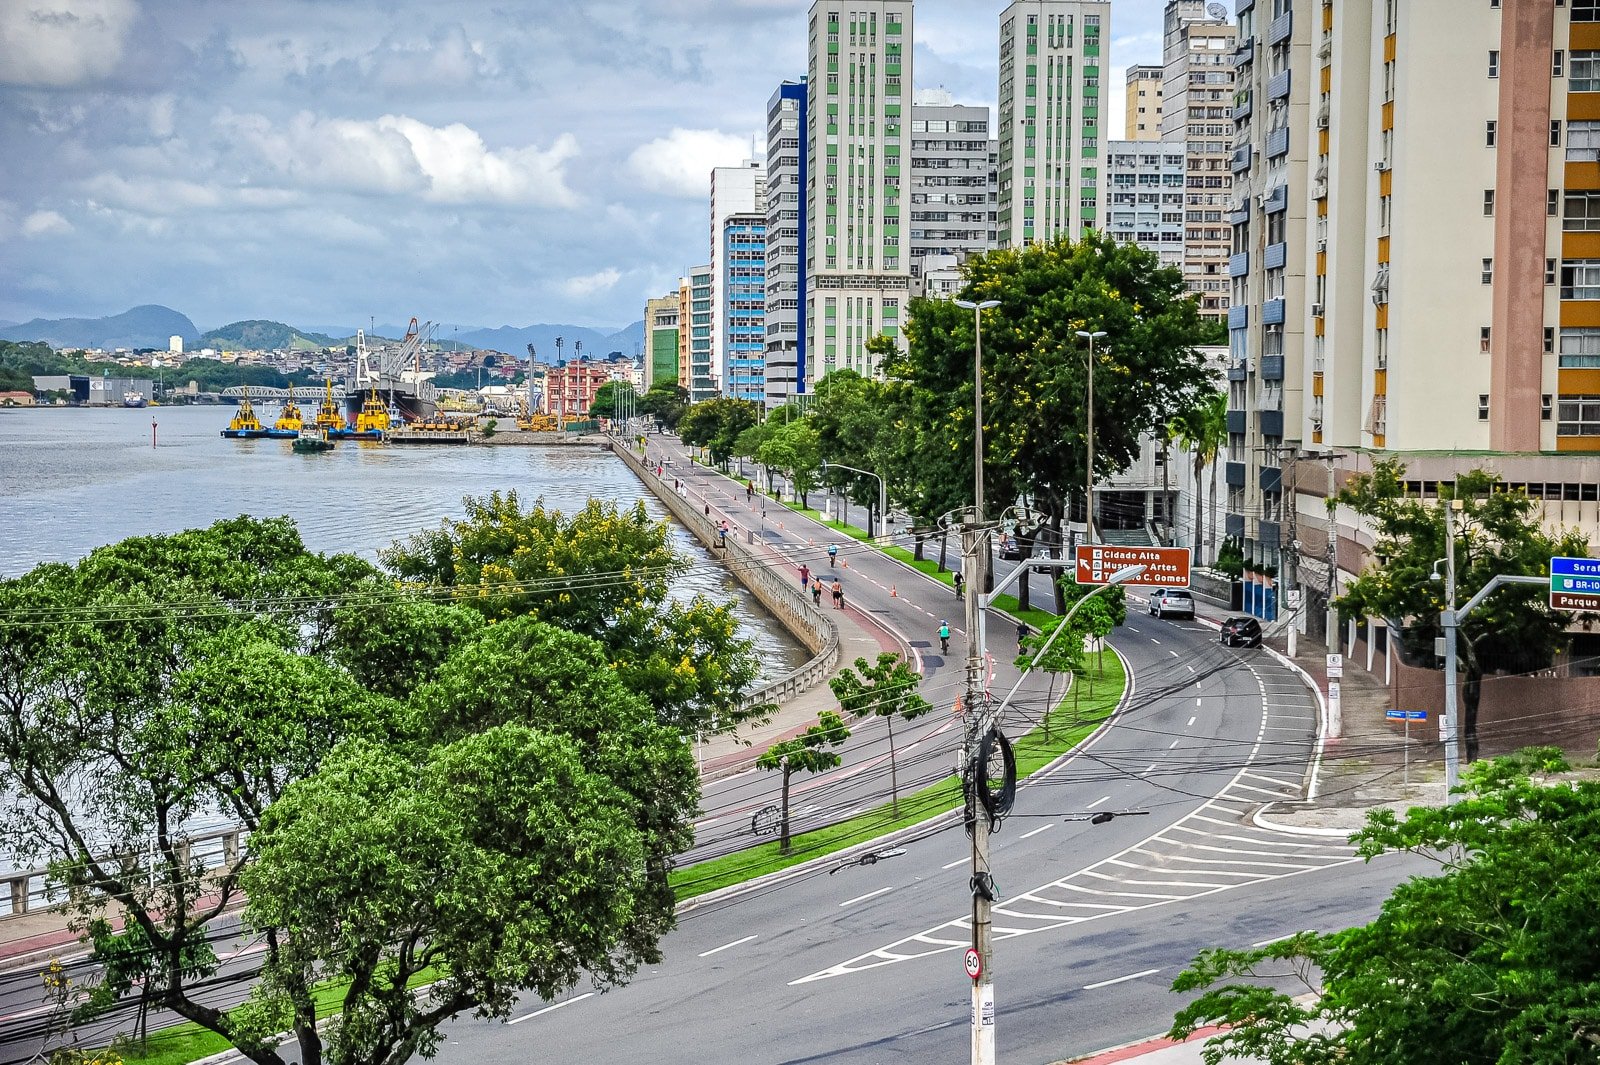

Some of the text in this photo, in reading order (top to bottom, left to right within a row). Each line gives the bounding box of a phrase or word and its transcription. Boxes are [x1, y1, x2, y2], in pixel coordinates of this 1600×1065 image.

[1103, 551, 1160, 560] Cidade Alta
[1150, 563, 1177, 572] Artes
[1144, 574, 1152, 582] C.
[1154, 574, 1187, 583] Gomes
[1575, 580, 1600, 590] BR-10
[1560, 596, 1598, 608] Parque
[967, 955, 978, 968] 60
